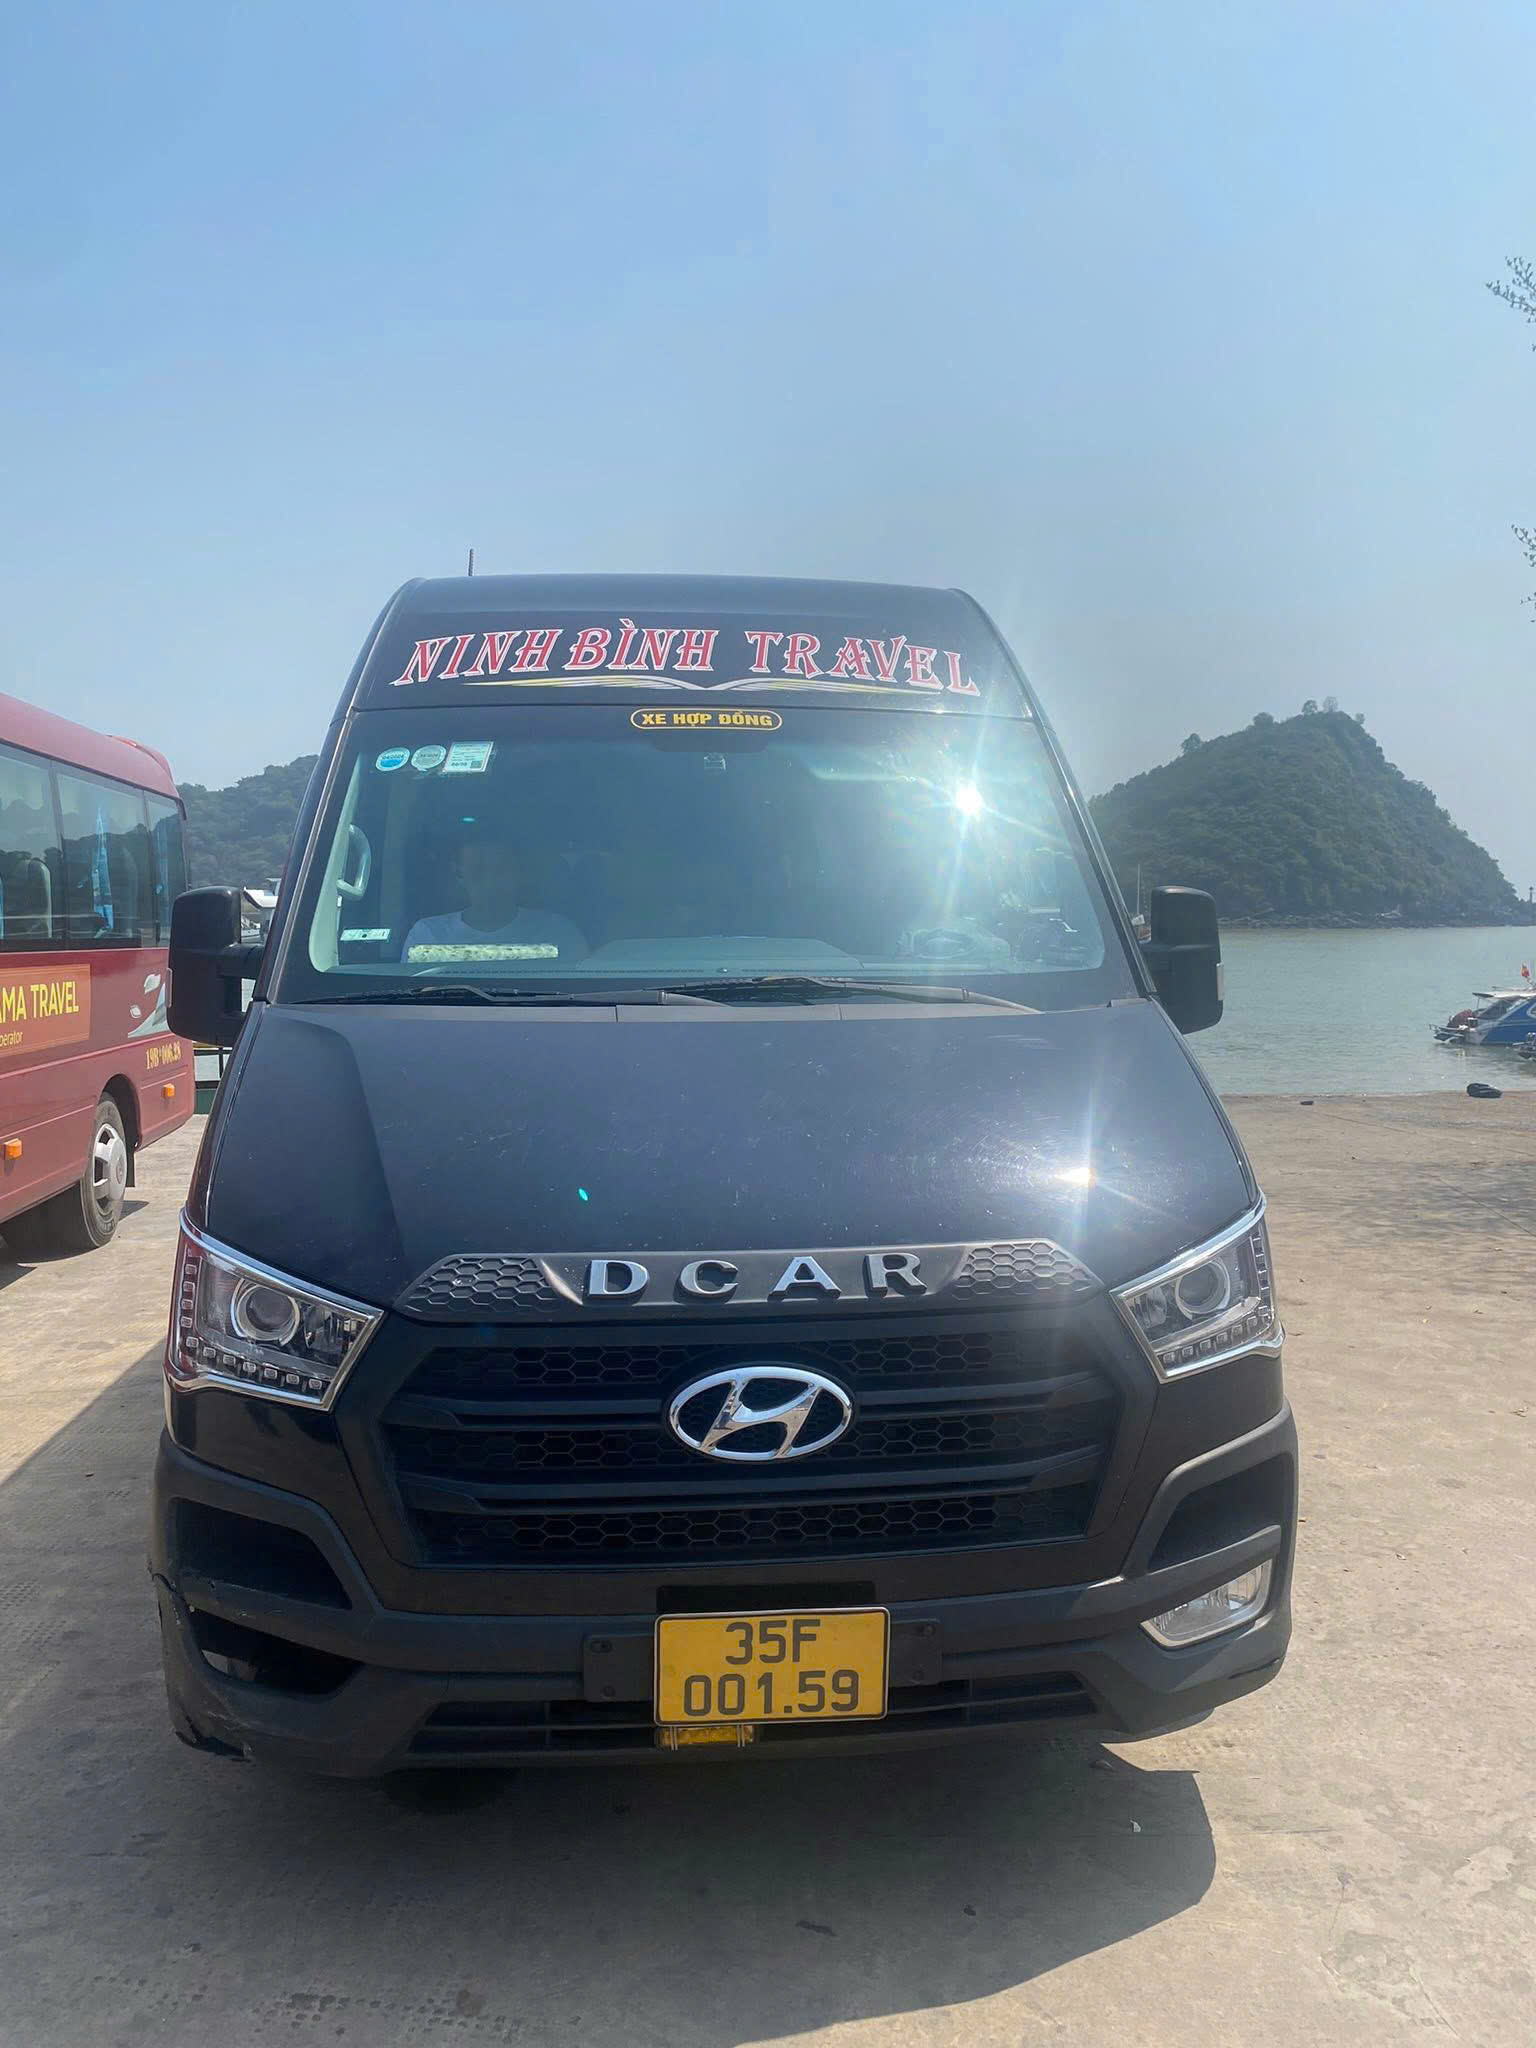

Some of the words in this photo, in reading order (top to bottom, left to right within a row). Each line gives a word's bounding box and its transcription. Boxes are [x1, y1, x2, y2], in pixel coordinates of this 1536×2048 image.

[392, 628, 564, 687] NINH
[565, 617, 719, 673] BÌNH
[744, 630, 982, 697] TRAVEL
[641, 713, 667, 725] XE
[673, 712, 712, 727] HỢP
[718, 710, 773, 726] ĐỒNG
[0, 986, 27, 1024] MA
[30, 980, 80, 1018] TRAVEL
[584, 1252, 928, 1303] DCAR
[725, 1618, 821, 1665] 35F
[683, 1669, 860, 1717] 001.59
